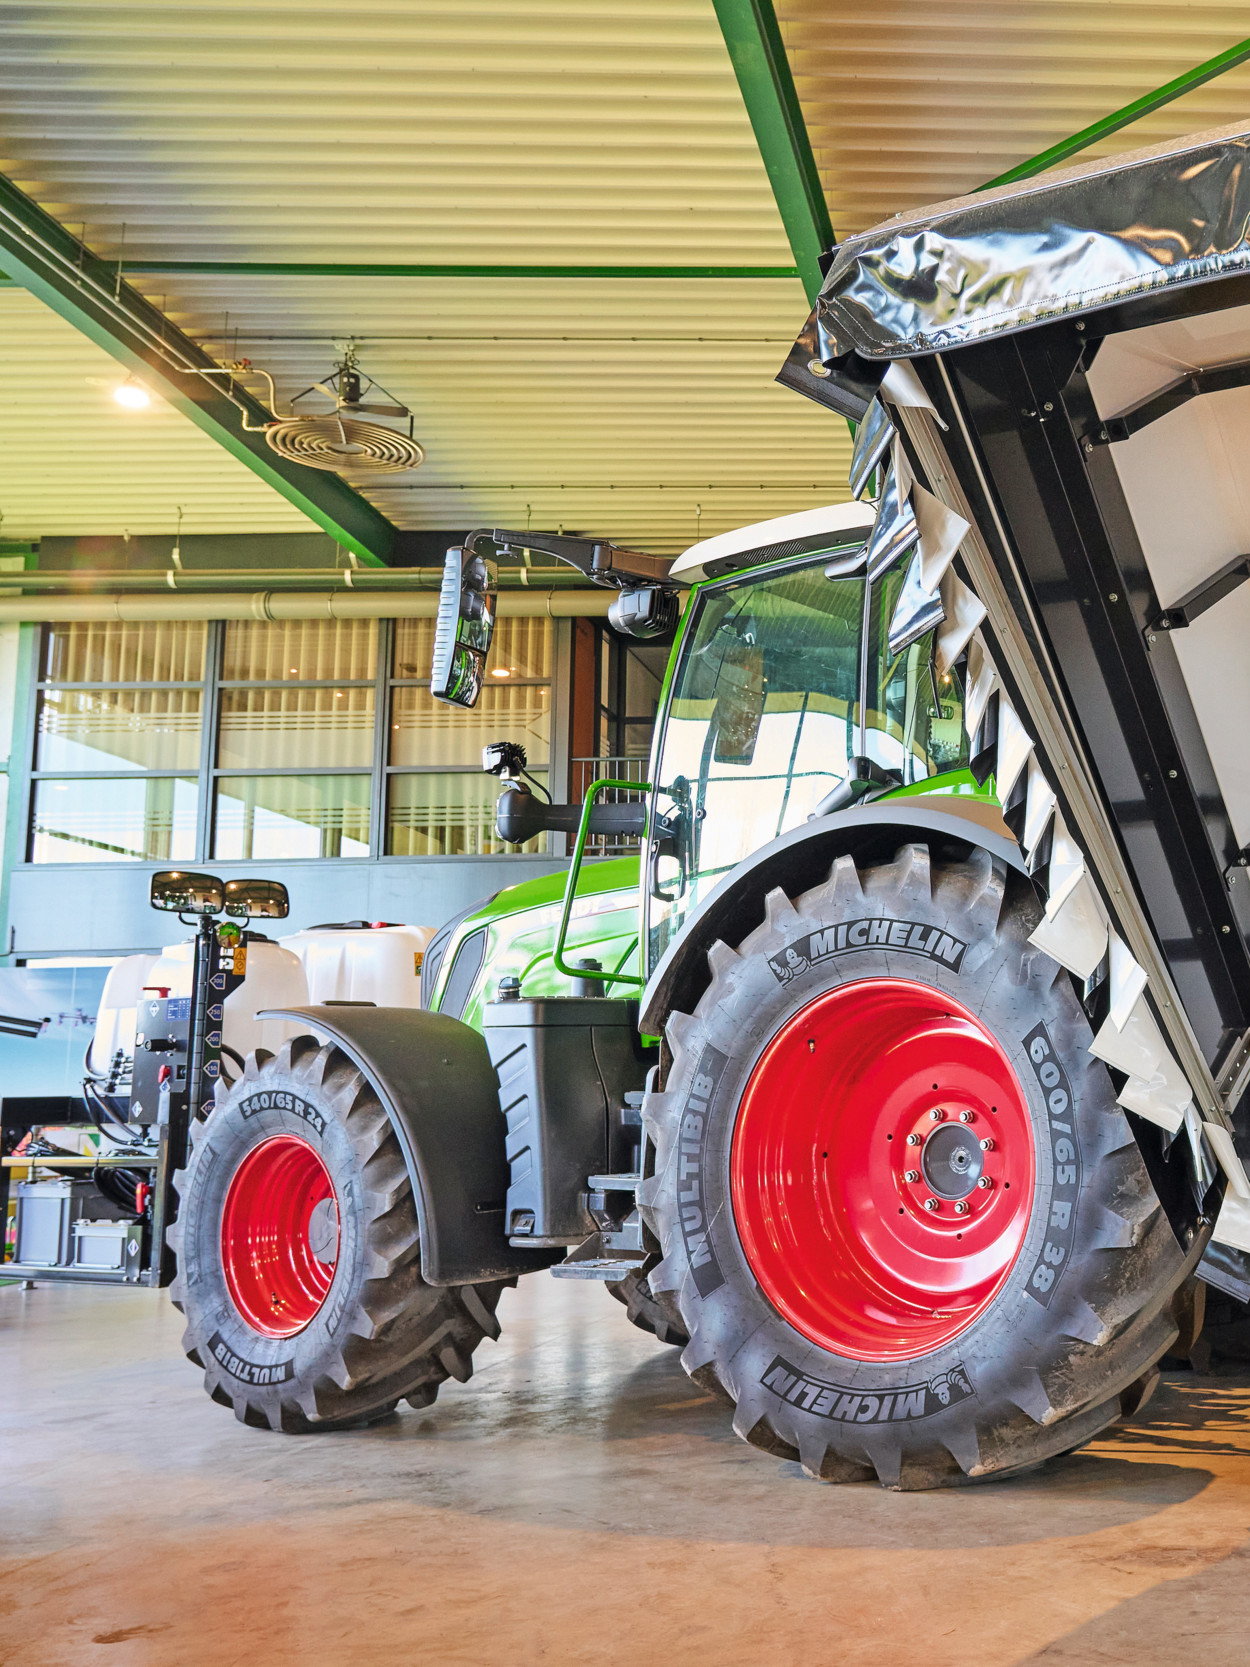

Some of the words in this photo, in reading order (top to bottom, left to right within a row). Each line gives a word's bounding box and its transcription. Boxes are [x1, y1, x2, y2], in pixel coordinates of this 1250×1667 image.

[809, 920, 965, 964] MICHELIN
[242, 1092, 293, 1117] 540/65
[294, 1099, 305, 1117] R
[306, 1107, 323, 1132] 24
[1029, 1036, 1076, 1186] 600/65
[679, 1072, 714, 1270] MULTIBIB
[185, 1145, 214, 1257] MICHELIN
[1052, 1200, 1073, 1231] R
[327, 1214, 357, 1335] MICHELIN
[1032, 1241, 1066, 1293] 38
[214, 1342, 286, 1384] MULTIBIB
[762, 1365, 927, 1423] MICHELIN
